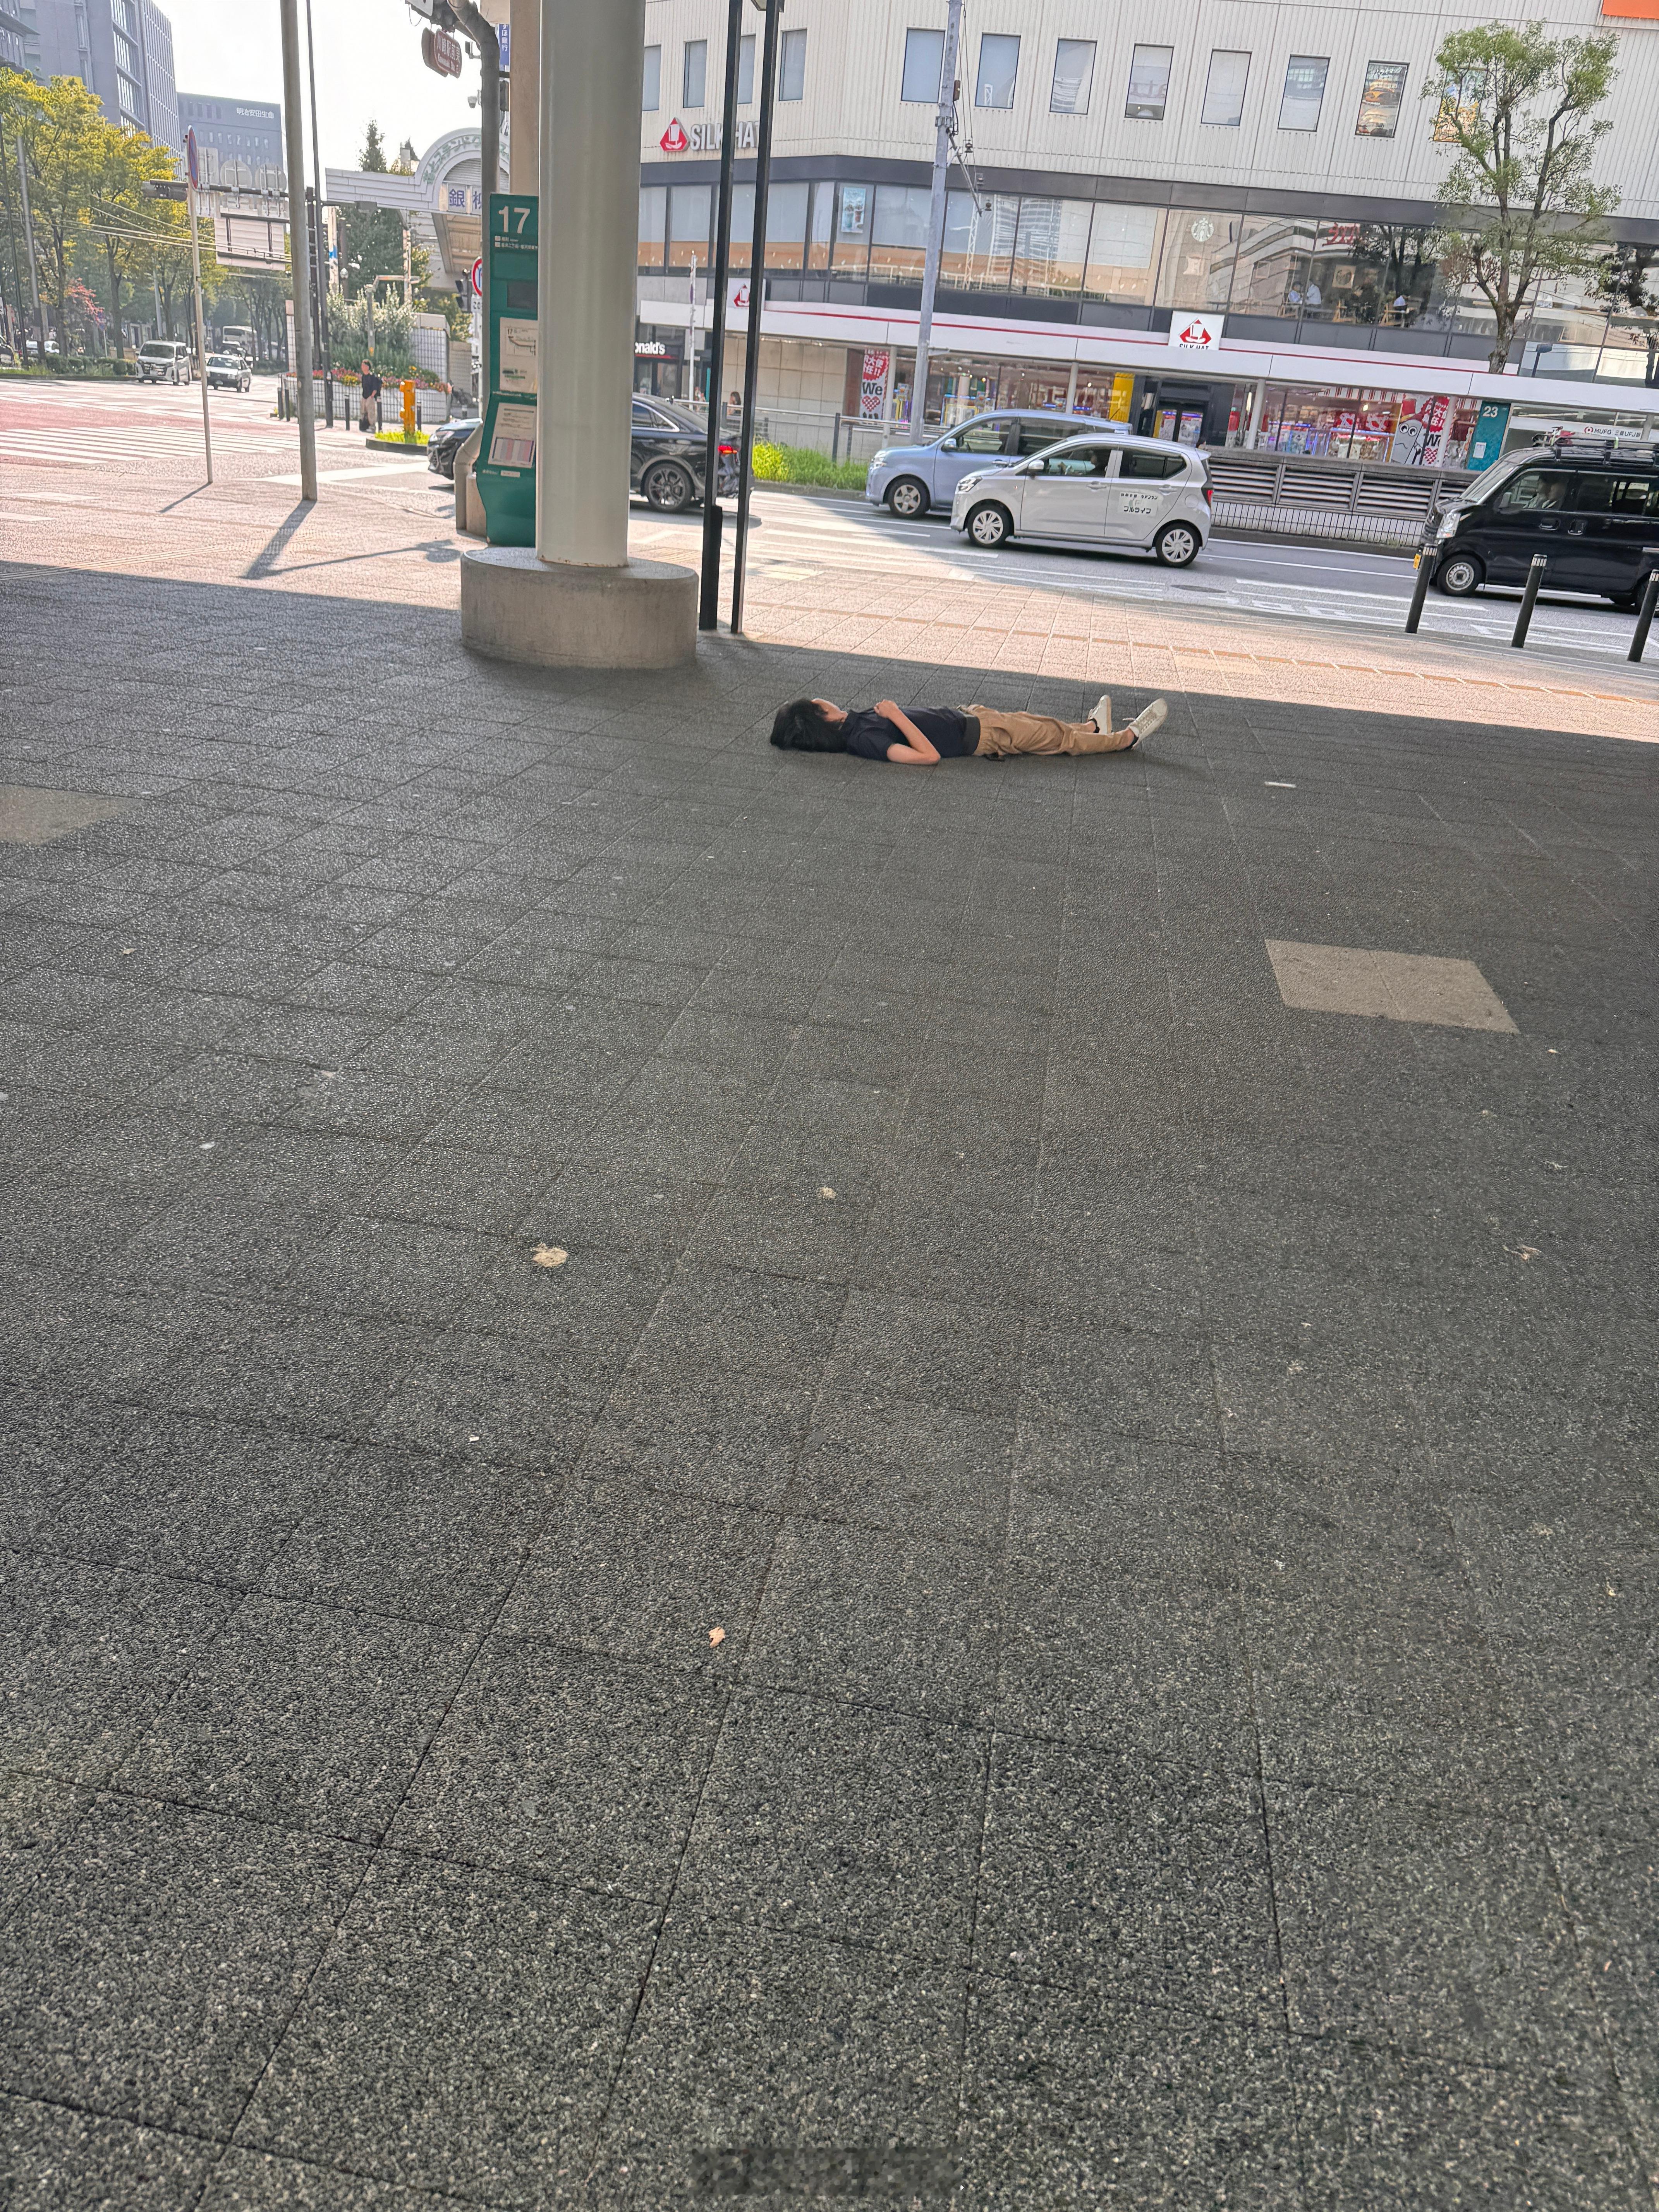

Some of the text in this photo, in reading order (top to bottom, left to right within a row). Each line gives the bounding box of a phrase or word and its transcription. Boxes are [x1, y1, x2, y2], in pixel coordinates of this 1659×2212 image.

[237, 107, 274, 118] 明治安田生命
[735, 121, 760, 148] HA
[498, 206, 530, 234] 17
[862, 381, 883, 395] We
[1482, 406, 1498, 418] 23
